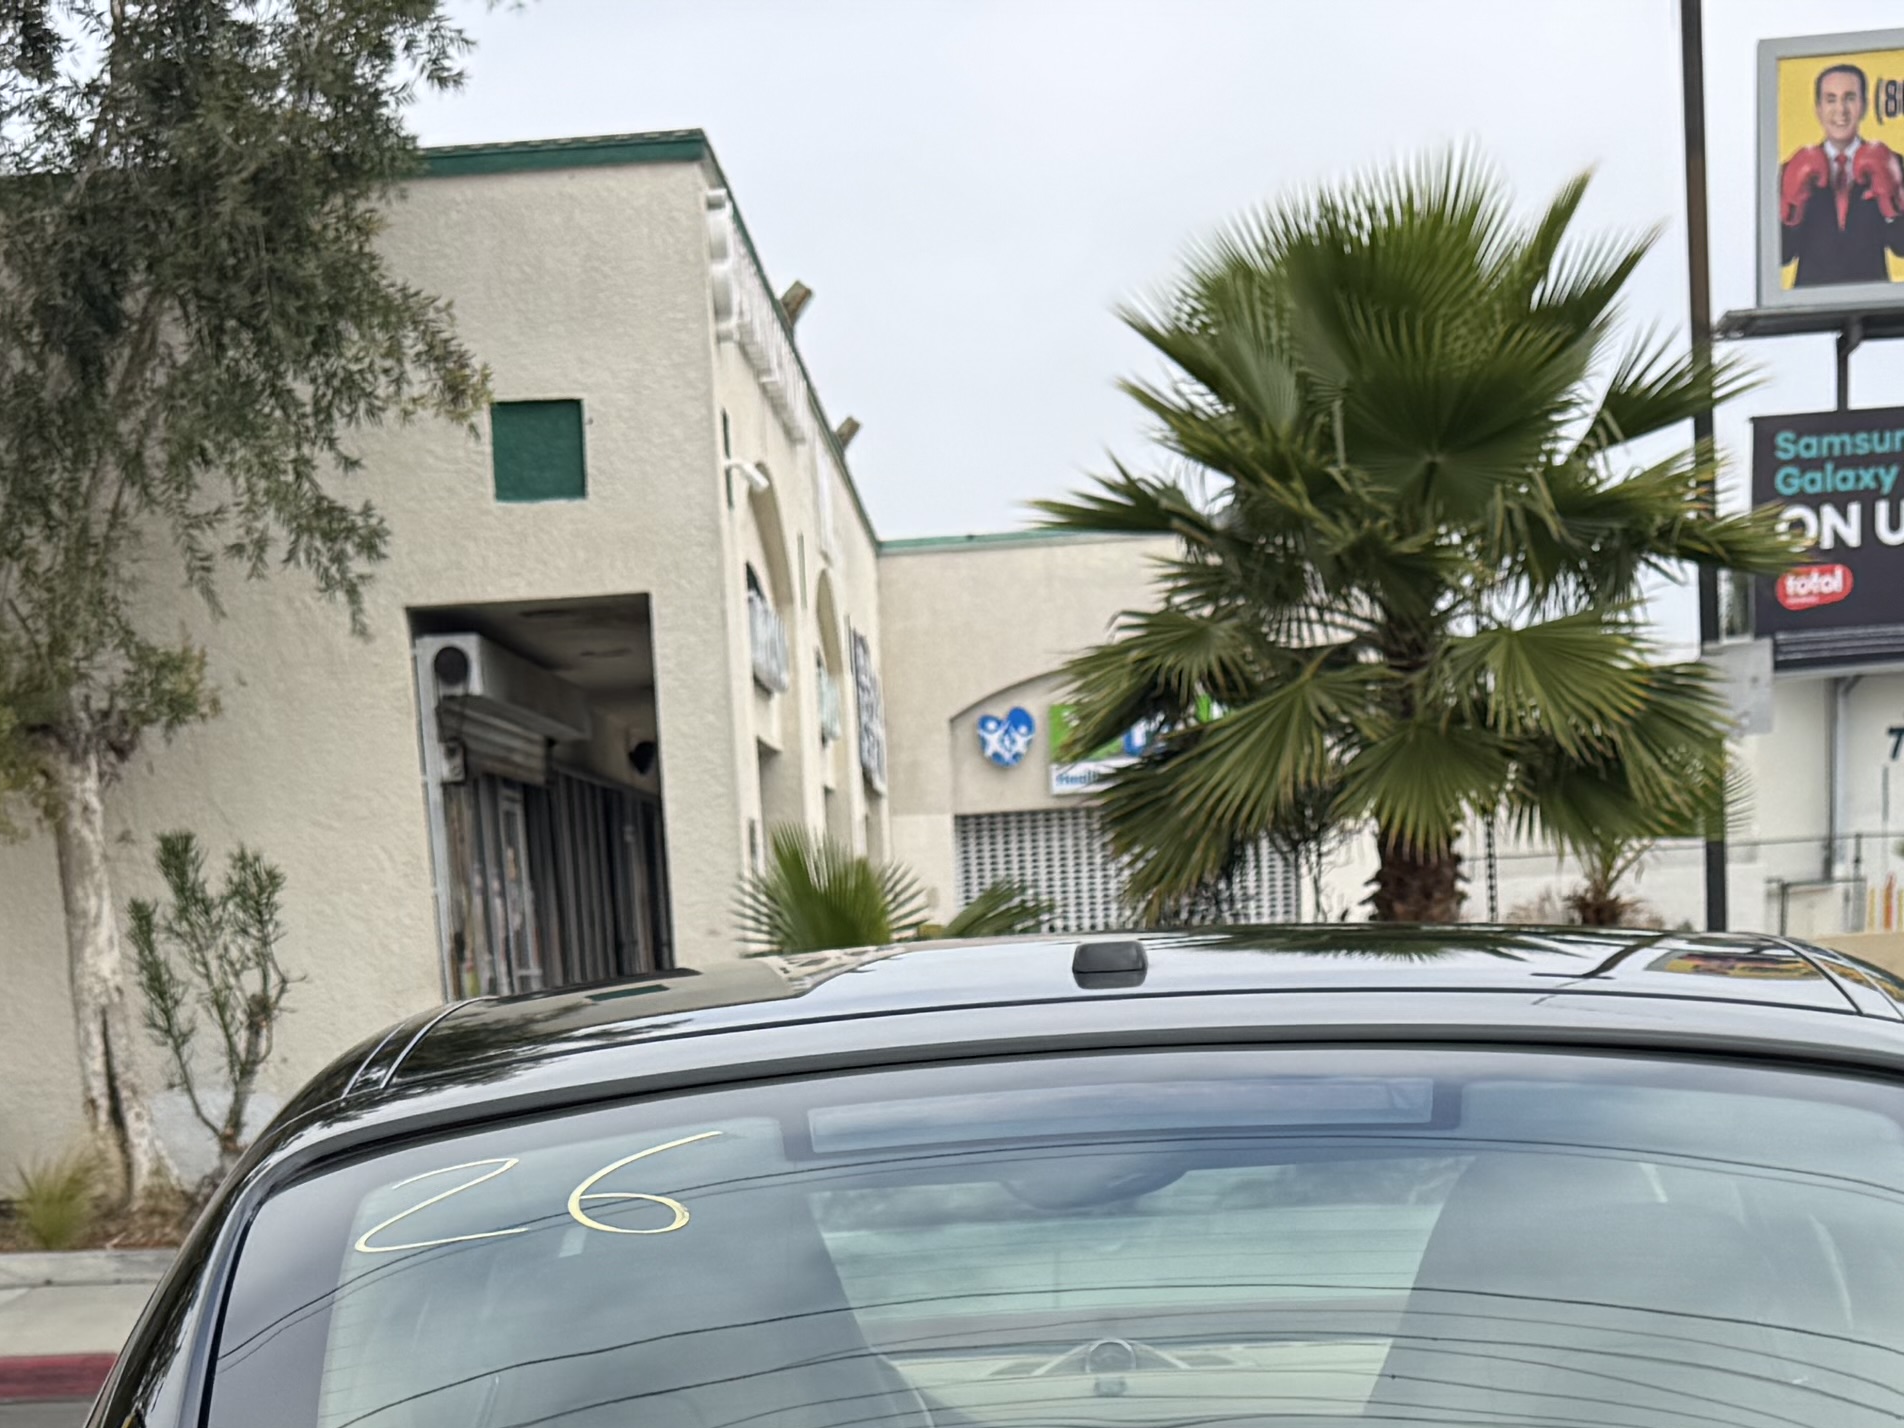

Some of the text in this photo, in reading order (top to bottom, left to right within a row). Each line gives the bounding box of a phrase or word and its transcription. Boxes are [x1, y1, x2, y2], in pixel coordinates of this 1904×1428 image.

[1774, 462, 1899, 497] Galaxy
[1774, 501, 1862, 553] ON
[1784, 569, 1845, 597] total
